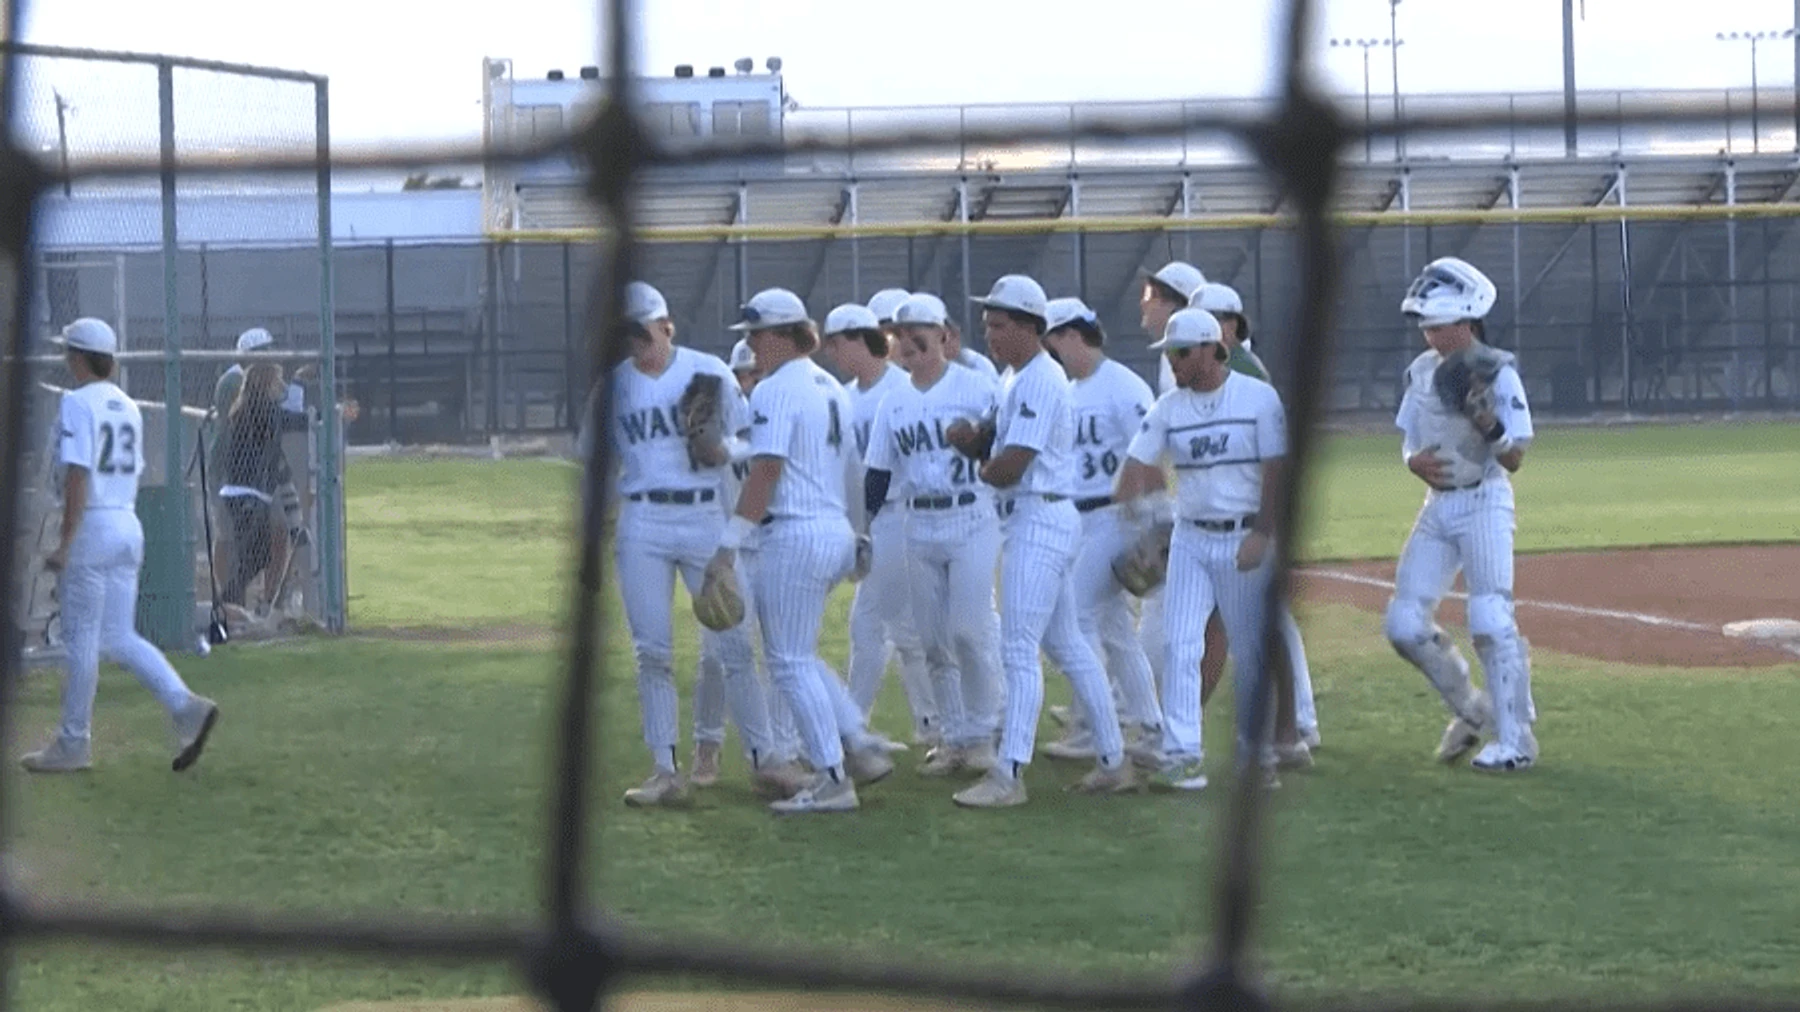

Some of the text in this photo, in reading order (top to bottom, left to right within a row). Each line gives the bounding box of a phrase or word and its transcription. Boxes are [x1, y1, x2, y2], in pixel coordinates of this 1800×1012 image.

[619, 405, 684, 444] WAL
[894, 418, 950, 456] WAL
[98, 421, 136, 473] 23
[1080, 450, 1118, 480] 30
